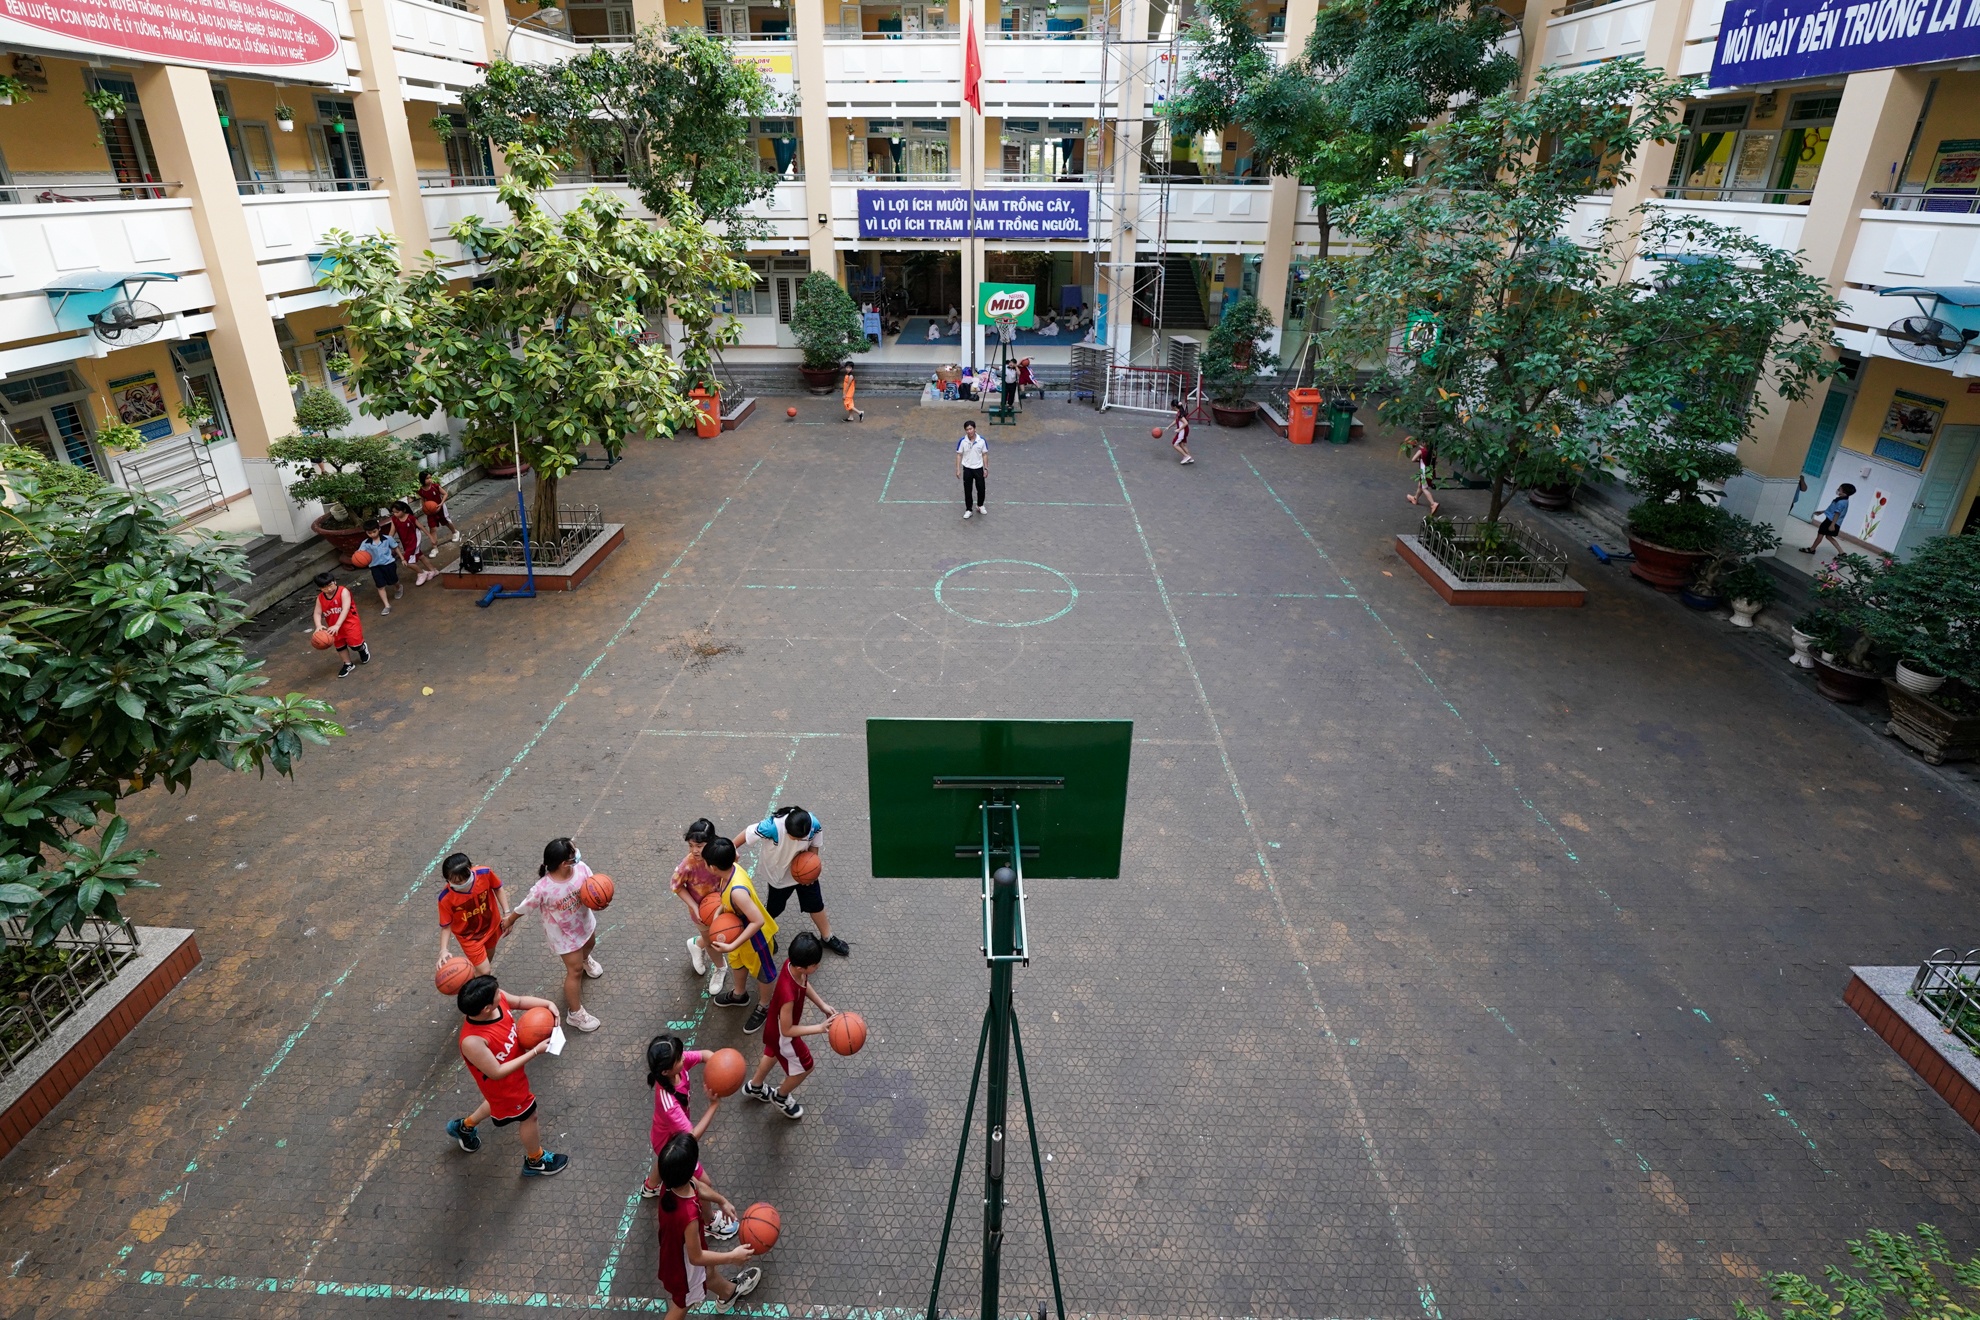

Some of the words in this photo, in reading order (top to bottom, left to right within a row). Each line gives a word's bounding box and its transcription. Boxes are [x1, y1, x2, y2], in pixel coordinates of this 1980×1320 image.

[269, 7, 285, 22] GIÁO
[283, 11, 297, 26] DỤC
[26, 2, 61, 24] LUYỆN
[60, 8, 82, 25] CON
[81, 11, 111, 30] NGƯỜI
[109, 12, 123, 32] VỀ
[122, 16, 133, 34] LÝ
[203, 31, 224, 48] NHÂN
[252, 38, 270, 55] SỐNG
[269, 41, 279, 56] VÀ
[277, 45, 289, 58] TAY
[212, 15, 227, 30] TẠO
[267, 24, 283, 39] GIÁO
[281, 28, 295, 43] DỤC
[1721, 9, 1756, 65] MỖI
[1750, 8, 1801, 60] NGÀY
[1797, 0, 1842, 53] ĐẾN
[872, 197, 885, 211] VÌ
[888, 198, 909, 213] LỢI
[912, 197, 932, 211] ÍCH
[936, 197, 968, 211] MƯỜI
[973, 198, 999, 212] NĂM
[1002, 196, 1044, 212] TRỒNG
[1046, 198, 1075, 214] CÂY,
[865, 216, 878, 230] VÌ
[881, 217, 901, 232] LỢI
[905, 216, 925, 230] ÍCH
[928, 217, 964, 230] TRĂM
[997, 215, 1039, 231] TRỒNG
[1042, 217, 1082, 231] NGƯỜI.
[991, 299, 1025, 311] MILO
